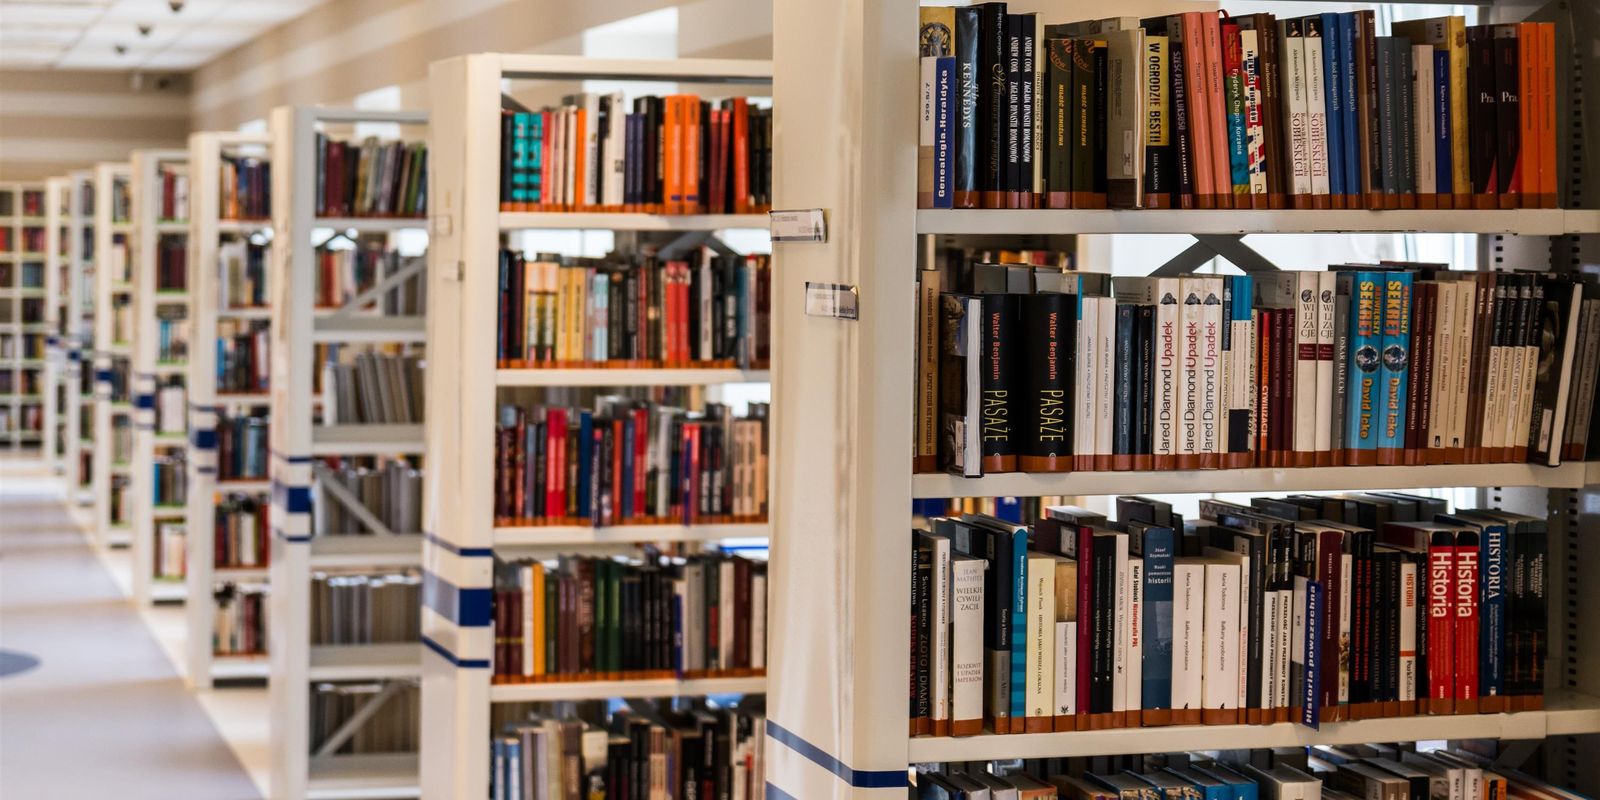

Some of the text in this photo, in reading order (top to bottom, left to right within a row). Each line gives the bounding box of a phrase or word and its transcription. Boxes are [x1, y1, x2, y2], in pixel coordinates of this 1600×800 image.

[1011, 36, 1019, 58] ANDREW
[1011, 58, 1019, 73] COOK
[1024, 36, 1032, 58] ANDREW
[1024, 58, 1032, 73] COOK
[962, 62, 972, 128] KENNEDYS
[1149, 43, 1161, 143] W OGRODZIE BESTII
[1232, 68, 1241, 98] Fryderyk
[1291, 113, 1304, 177] SOBIESKICH
[1310, 113, 1323, 177] SOBIESKICH
[1303, 303, 1314, 311] WI
[1303, 321, 1314, 329] ZA
[1323, 304, 1333, 312] WI
[1323, 322, 1333, 330] ZA
[1358, 281, 1373, 336] SEKRET
[1385, 280, 1402, 336] SEKRET
[991, 312, 1001, 380] Walter Benjamin
[1047, 312, 1057, 380] Walter Benjamin
[984, 390, 1012, 442] PASAŻE
[1040, 390, 1067, 442] PASAŻE
[1159, 321, 1175, 455] Jared Diamond Upadek
[1183, 321, 1199, 454] Jared Diamond Upadek
[1202, 321, 1218, 454] Jared Diamond Upadek
[1261, 385, 1269, 438] CYWILIZACJE
[1360, 378, 1373, 439] David Icke
[1387, 377, 1400, 438] David Icke
[1432, 552, 1452, 617] Historia
[1457, 552, 1478, 617] Historia
[1488, 532, 1501, 599] HISTORIA
[1304, 585, 1316, 724] Historia powszechna
